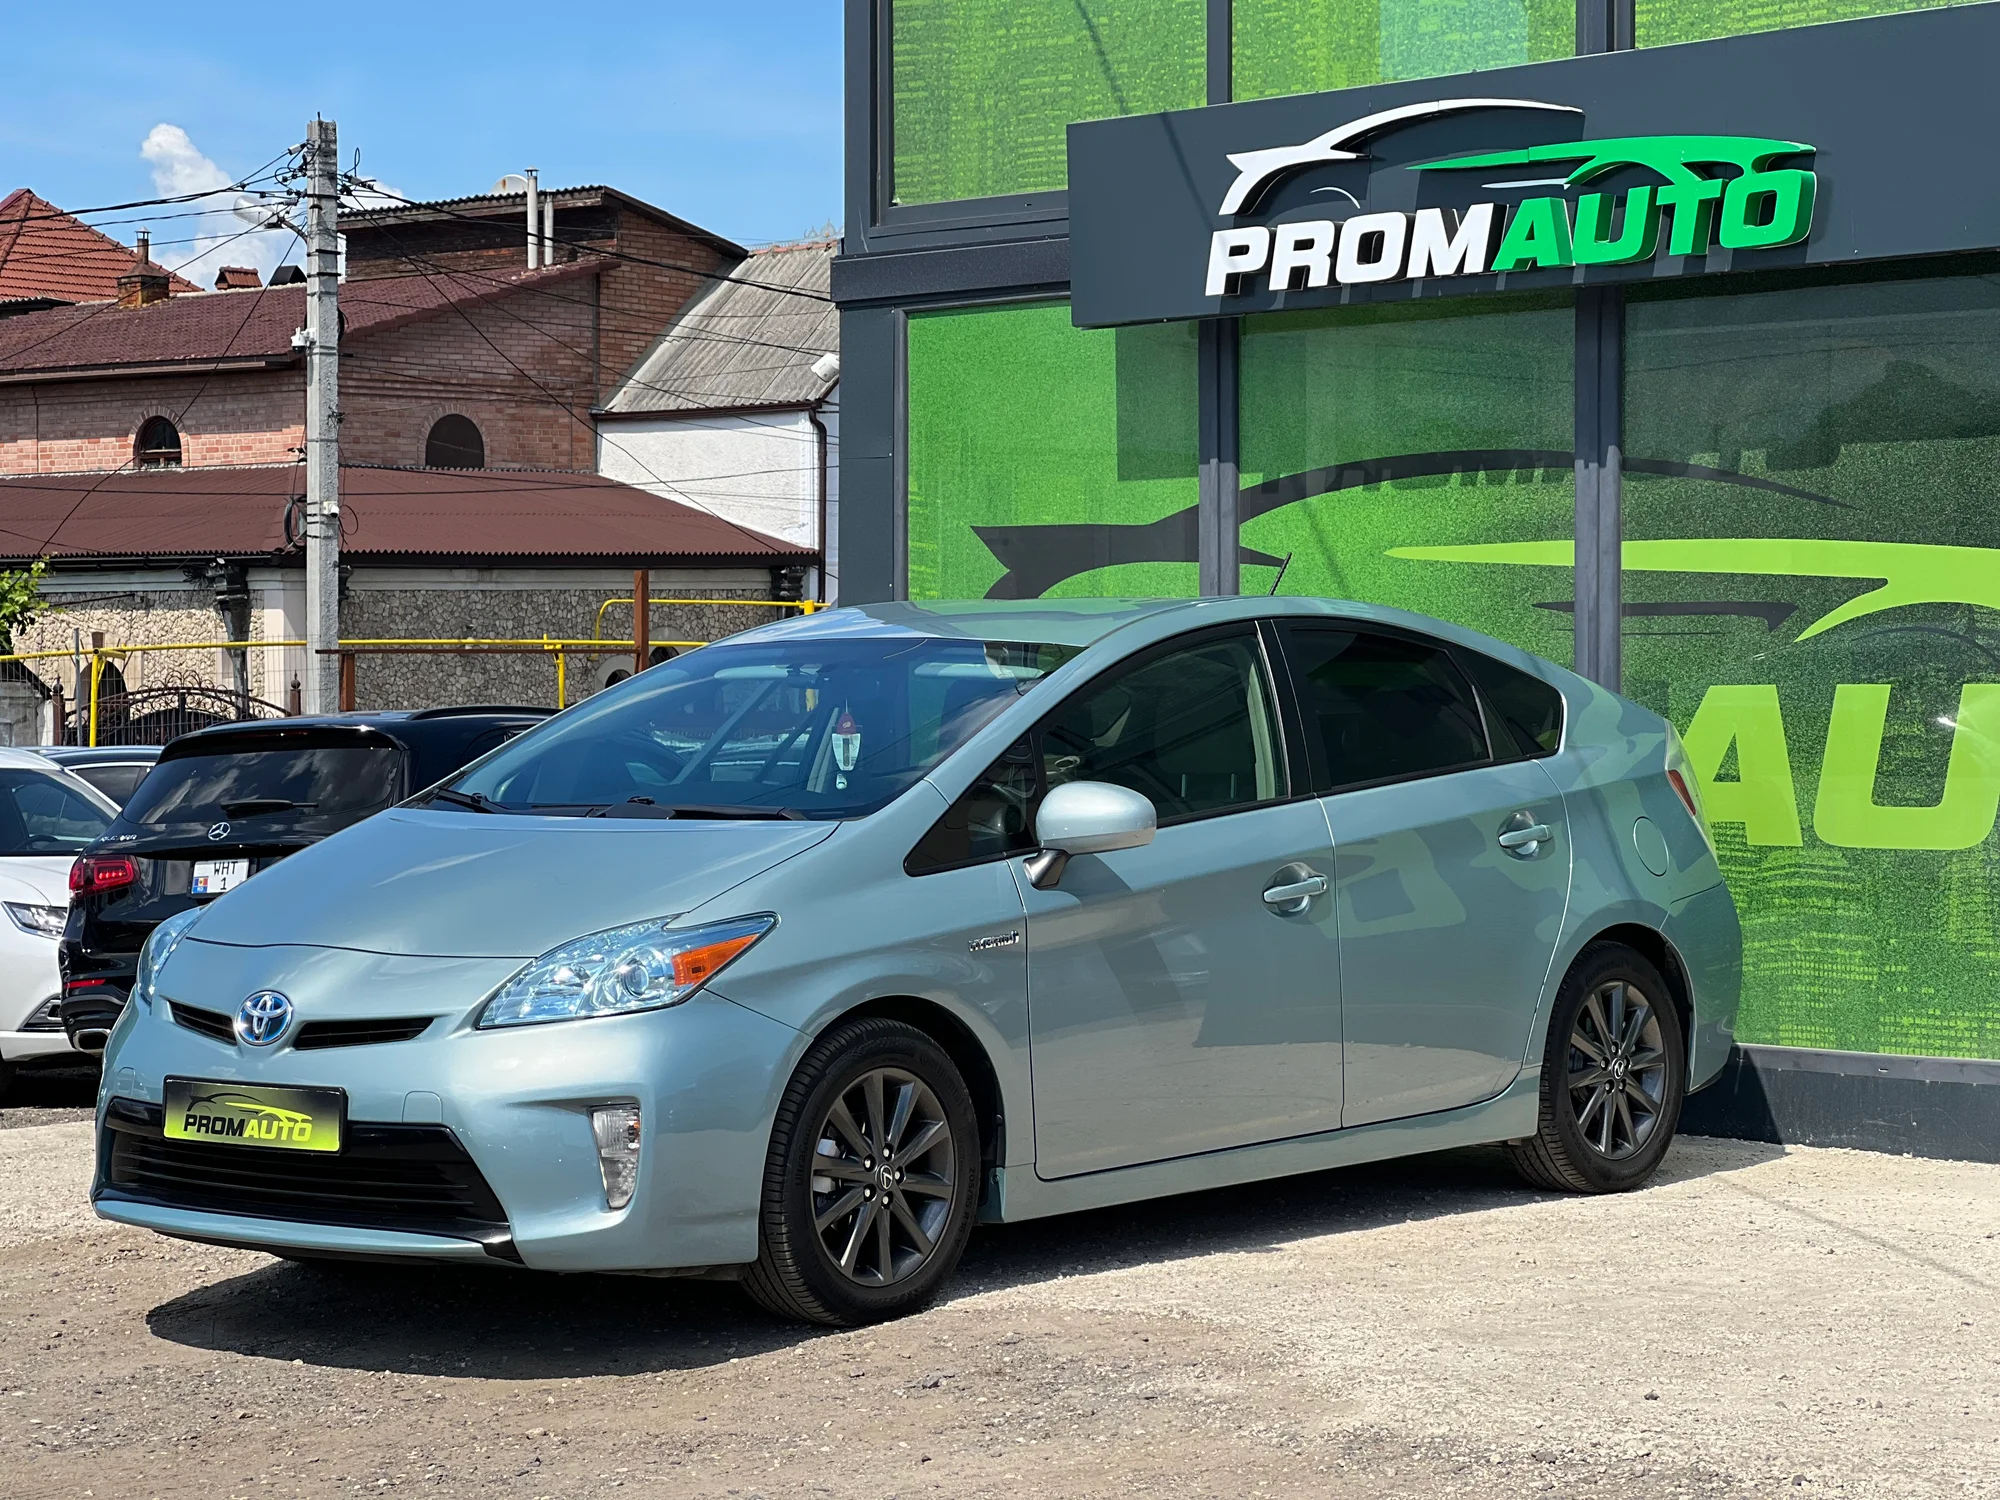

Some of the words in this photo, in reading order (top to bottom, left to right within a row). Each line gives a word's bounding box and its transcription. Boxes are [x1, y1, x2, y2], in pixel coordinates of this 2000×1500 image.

[1205, 168, 1817, 297] PROMAUTO
[214, 861, 238, 875] WHT
[220, 877, 227, 890] 1
[183, 1112, 313, 1142] PROMAUTO
